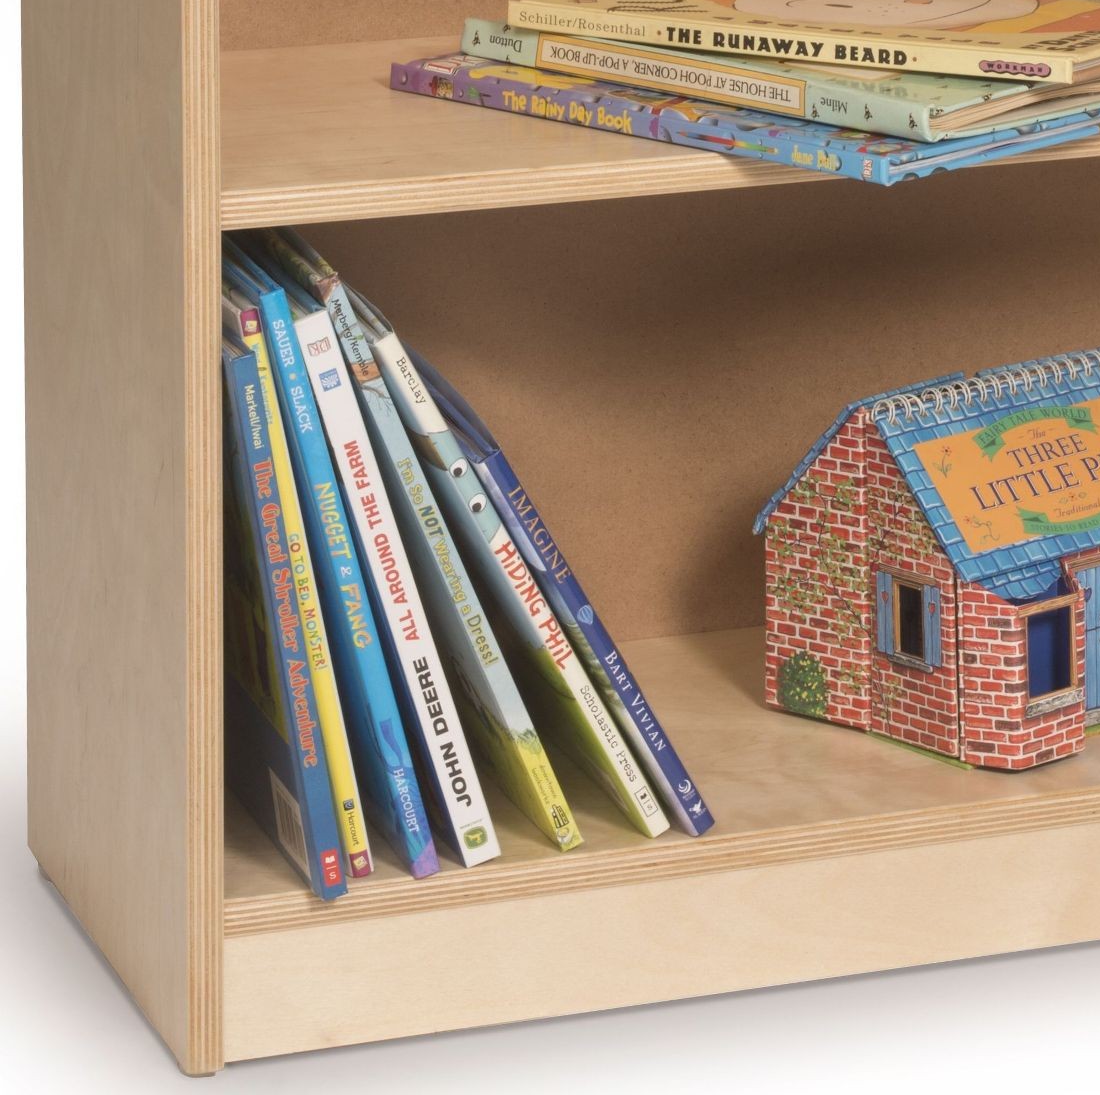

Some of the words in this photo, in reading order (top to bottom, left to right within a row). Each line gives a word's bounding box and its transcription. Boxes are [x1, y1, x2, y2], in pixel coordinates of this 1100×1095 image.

[519, 10, 646, 37] Schiller/Rosenthal
[489, 34, 523, 53] Dutton
[550, 45, 581, 63] BOOK
[582, 50, 620, 69] POP-UP
[666, 26, 702, 45] THE
[713, 31, 824, 57] RUNAWAY
[834, 44, 908, 66] BEARD
[622, 60, 630, 72] A
[632, 58, 678, 81] CORNER,
[679, 68, 712, 88] POOH
[713, 75, 728, 90] AT
[986, 61, 1044, 74] WORKMAN
[729, 78, 767, 96] HOUSE
[768, 86, 792, 103] THE
[820, 96, 848, 113] Milne
[502, 90, 527, 111] The
[569, 101, 593, 126] Day
[597, 106, 633, 134] Book
[272, 319, 295, 368] SAUER
[331, 298, 369, 377] Merberg/Kemble
[396, 356, 427, 404] Barclay
[290, 385, 313, 434] SLACK
[978, 423, 1006, 446] FAIRY
[1009, 411, 1036, 427] TALE
[1039, 407, 1088, 420] WORLD
[343, 439, 371, 491] FARM
[1006, 433, 1088, 469] THREE
[253, 457, 274, 499] The
[410, 484, 425, 505] So
[969, 462, 1081, 511] LITTLE
[314, 481, 352, 560] NUGGET
[360, 493, 383, 530] THE
[418, 504, 445, 538] NOT
[1053, 498, 1100, 518] Traditional
[260, 502, 288, 564] Great
[288, 533, 301, 553] GO
[507, 485, 571, 585] IMAGINE
[294, 556, 306, 575] TO
[340, 566, 352, 577] &
[374, 533, 408, 605] AROUND
[432, 537, 468, 604] Wearing
[271, 567, 300, 653] Stroller
[340, 583, 374, 649] FANG
[399, 608, 421, 641] ALL
[460, 604, 473, 616] a
[303, 607, 329, 671] MONSTER!
[466, 614, 500, 667] Dress!
[286, 659, 318, 769] Adventure
[413, 656, 449, 737] DEERE
[604, 650, 633, 692] BART
[631, 693, 666, 753] VIVIAN
[579, 684, 619, 750] Scholastic
[615, 750, 637, 783] Press
[439, 741, 472, 808] JOHN
[393, 767, 420, 833] HARCOURT
[347, 810, 359, 846] Harcourt
